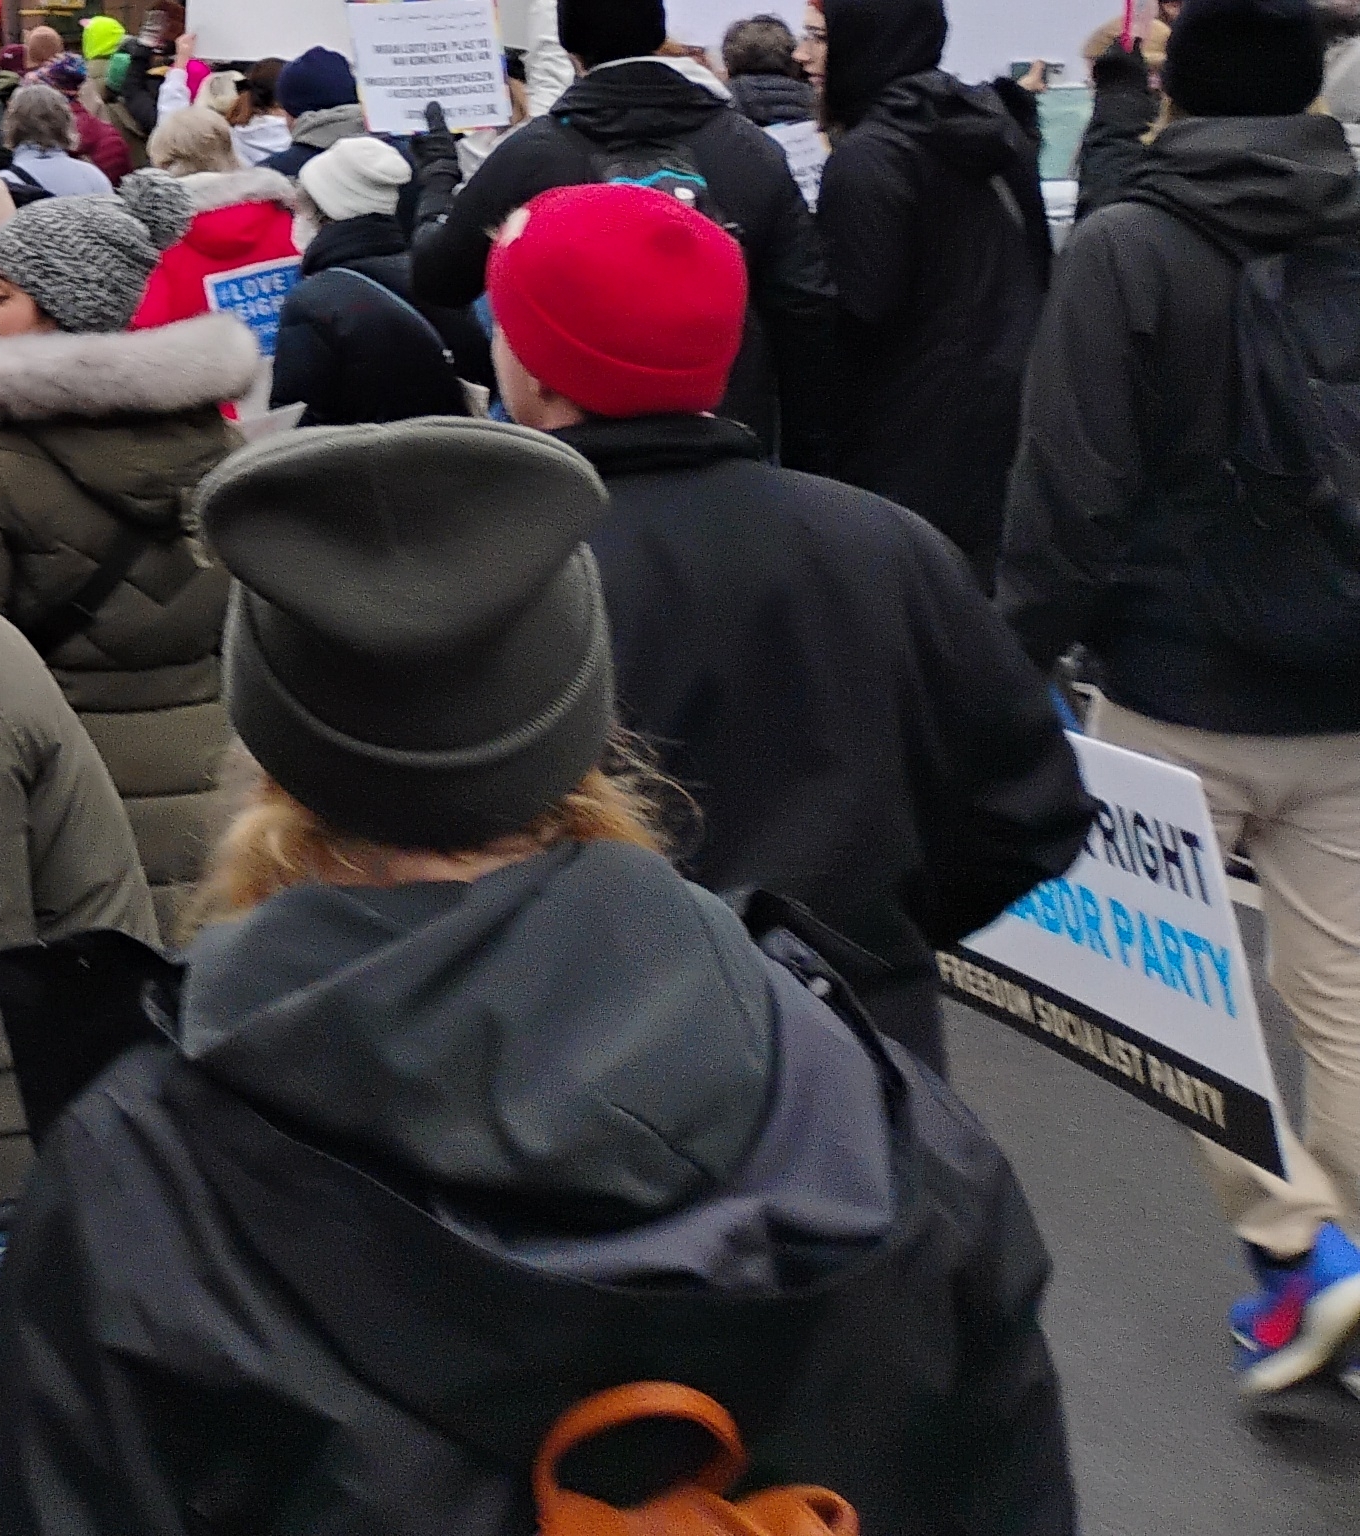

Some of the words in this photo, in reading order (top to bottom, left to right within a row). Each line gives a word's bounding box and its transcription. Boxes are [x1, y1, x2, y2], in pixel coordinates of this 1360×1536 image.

[1095, 800, 1211, 907] RIGHT
[1005, 877, 1112, 959] ABOR
[1109, 897, 1238, 1019] PARTY
[935, 950, 1035, 1024] FREEDOM
[1033, 995, 1145, 1085] SOCIALIST
[1146, 1052, 1226, 1130] PARTY
